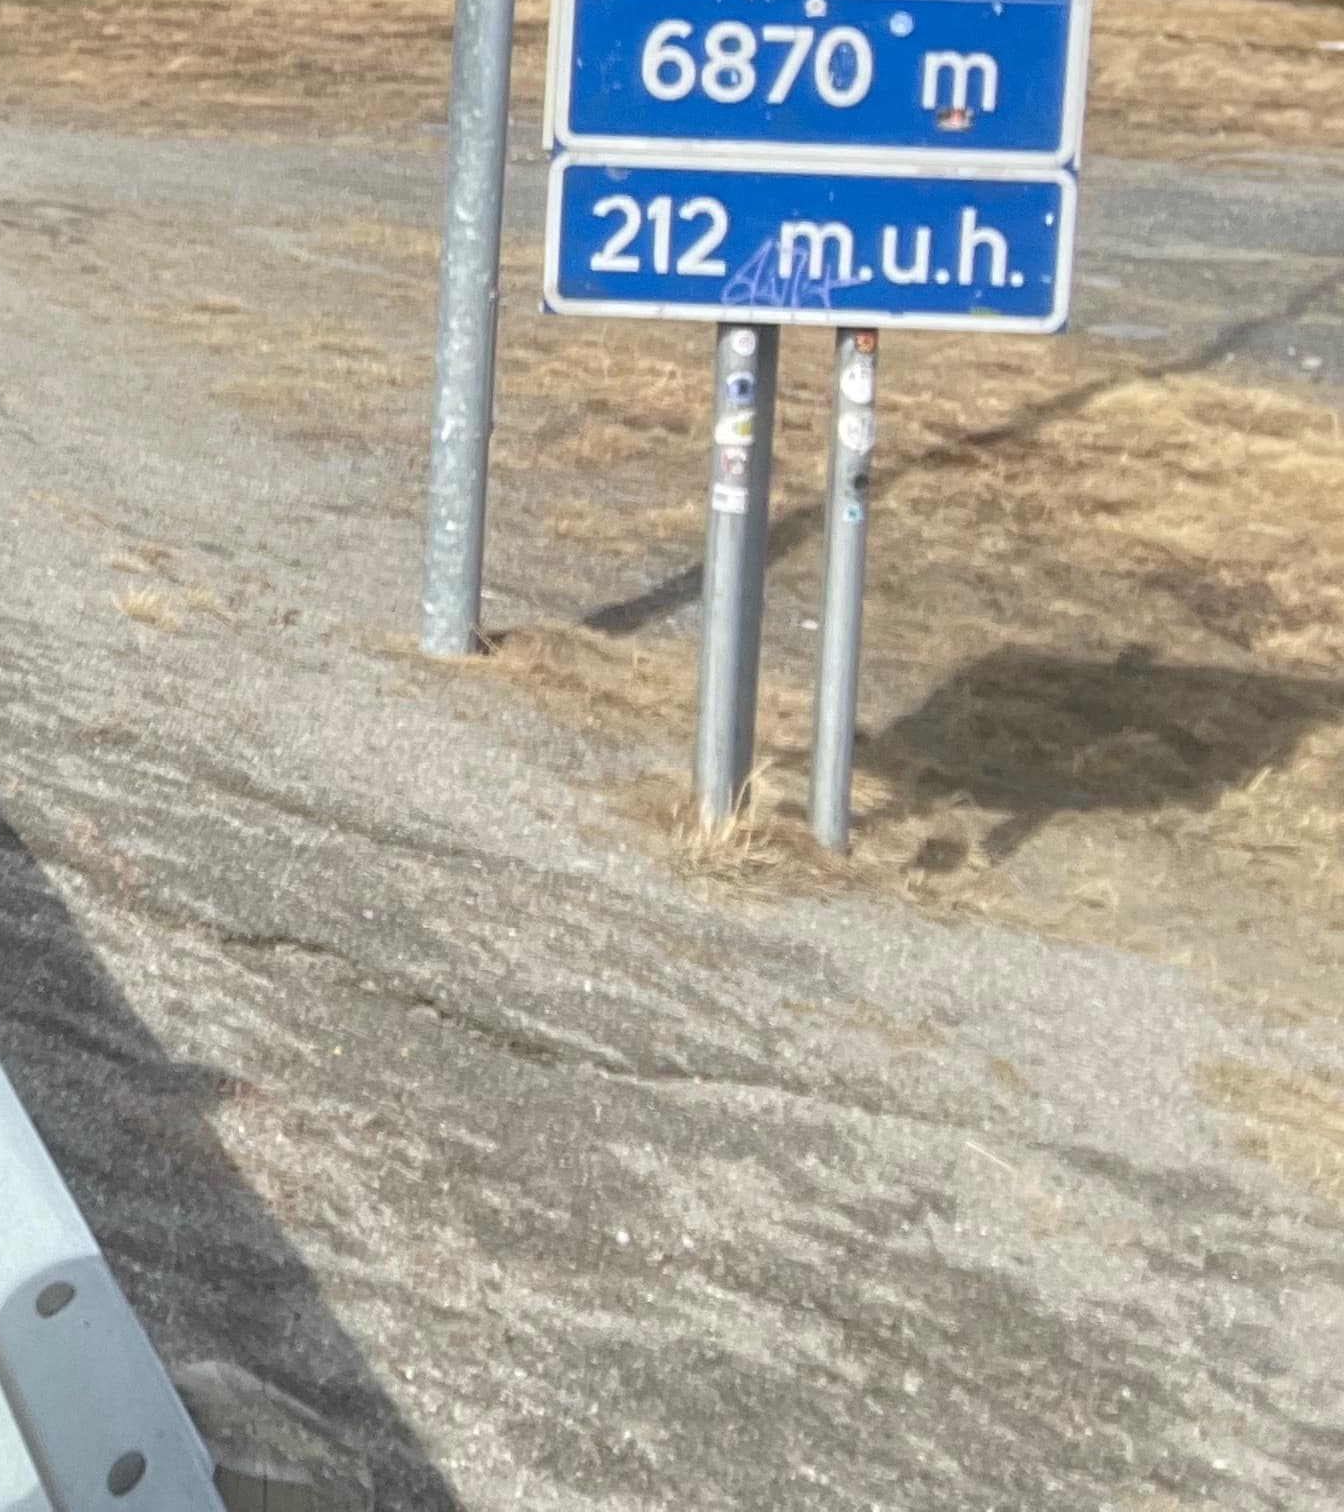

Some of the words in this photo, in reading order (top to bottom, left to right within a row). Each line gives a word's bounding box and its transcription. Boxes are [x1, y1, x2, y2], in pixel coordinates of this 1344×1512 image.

[641, 19, 873, 107] 6870
[922, 51, 998, 113] m
[590, 194, 728, 276] 212
[776, 207, 1025, 288] m.u.h.
